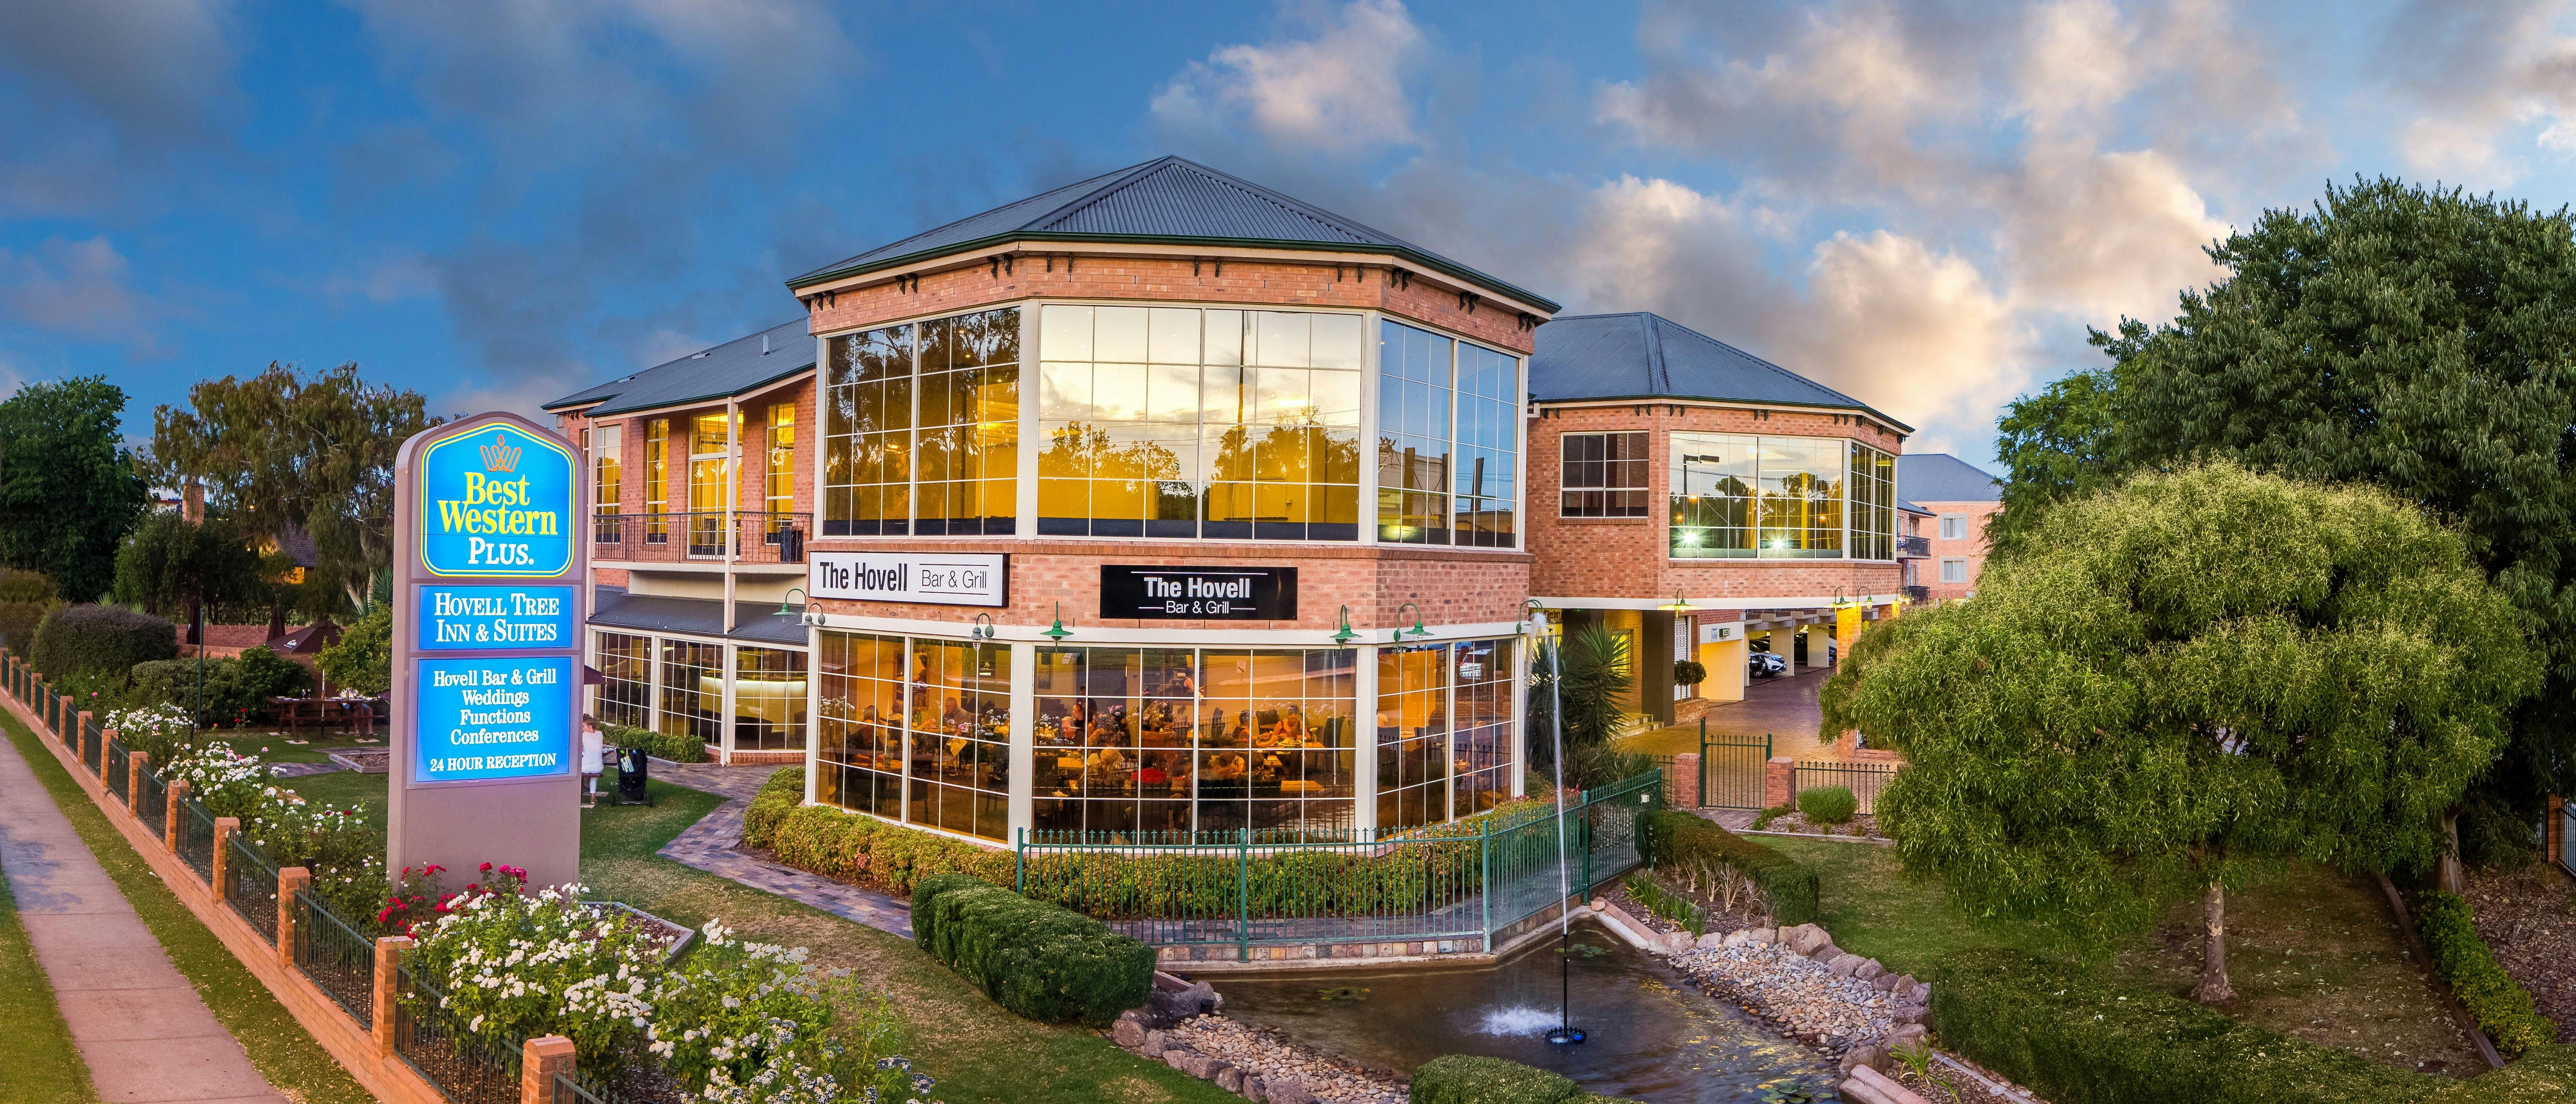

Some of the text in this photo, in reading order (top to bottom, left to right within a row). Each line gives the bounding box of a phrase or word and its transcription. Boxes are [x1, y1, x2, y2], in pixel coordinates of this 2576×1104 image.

[464, 472, 530, 506] Best
[437, 500, 558, 535] Western
[820, 562, 907, 591] The Hovell
[922, 570, 986, 588] Bar & Grill
[1144, 577, 1250, 597] The Hovell
[434, 593, 559, 616] HOVELL TREE
[1167, 601, 1229, 613] Bar & Grill
[436, 619, 556, 642] INN & SUITES
[434, 668, 556, 686] Hovell Bar & Grill
[462, 689, 529, 707] Weddings
[460, 708, 530, 725] Functions
[451, 728, 539, 745] Conferences
[430, 753, 556, 771] 24 HOUR RECEPTION
